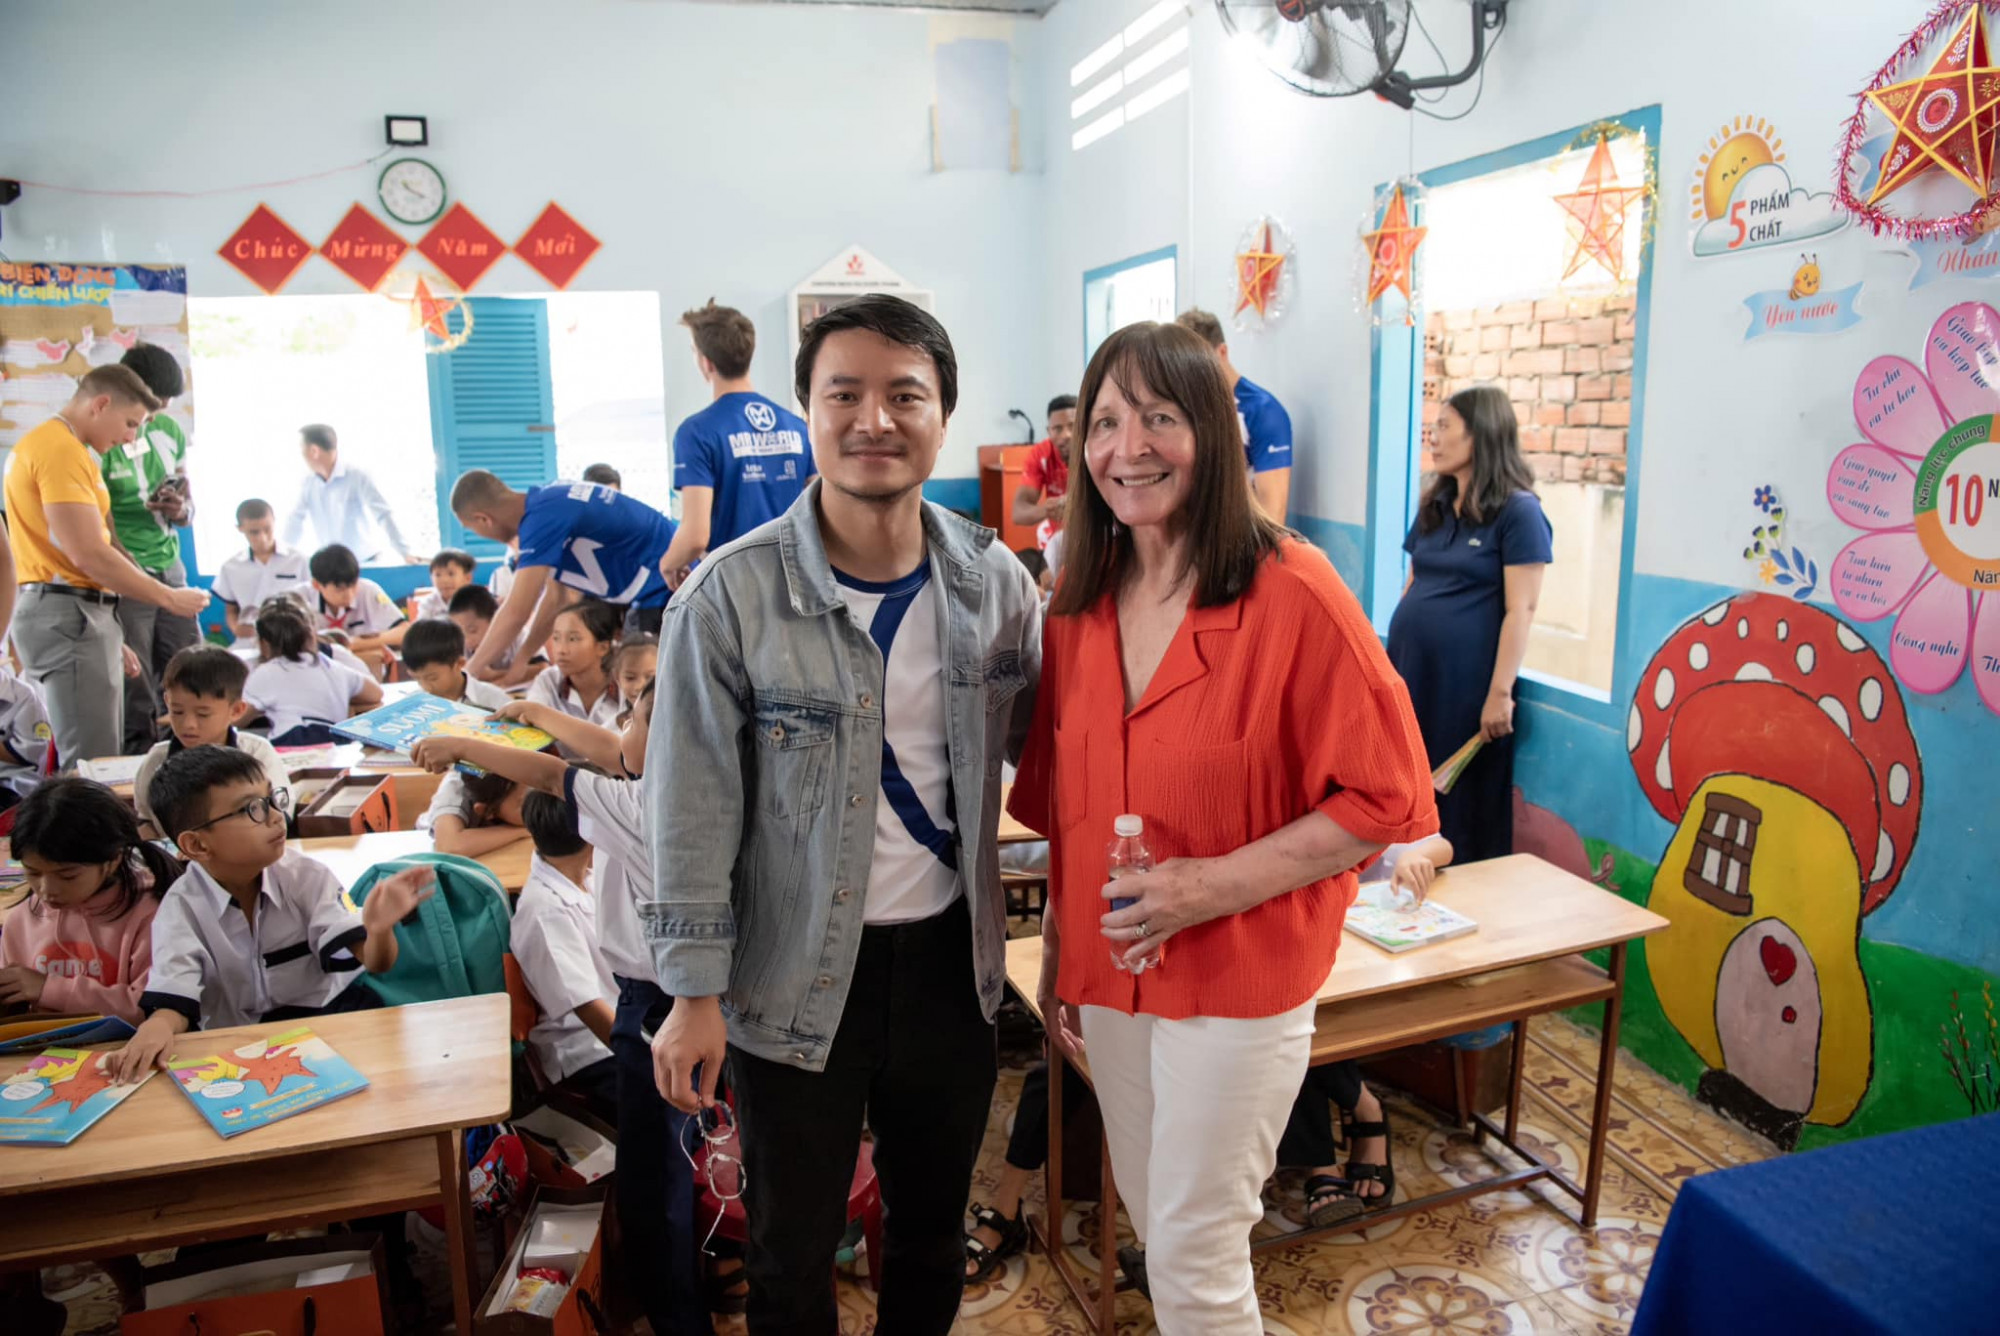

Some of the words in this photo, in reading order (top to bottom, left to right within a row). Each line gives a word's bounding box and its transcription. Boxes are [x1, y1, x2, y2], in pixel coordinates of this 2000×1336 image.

[1728, 199, 1747, 249] 5
[1749, 218, 1782, 242] CHẤT
[234, 236, 298, 260] Chúc
[1945, 473, 1985, 527] 10
